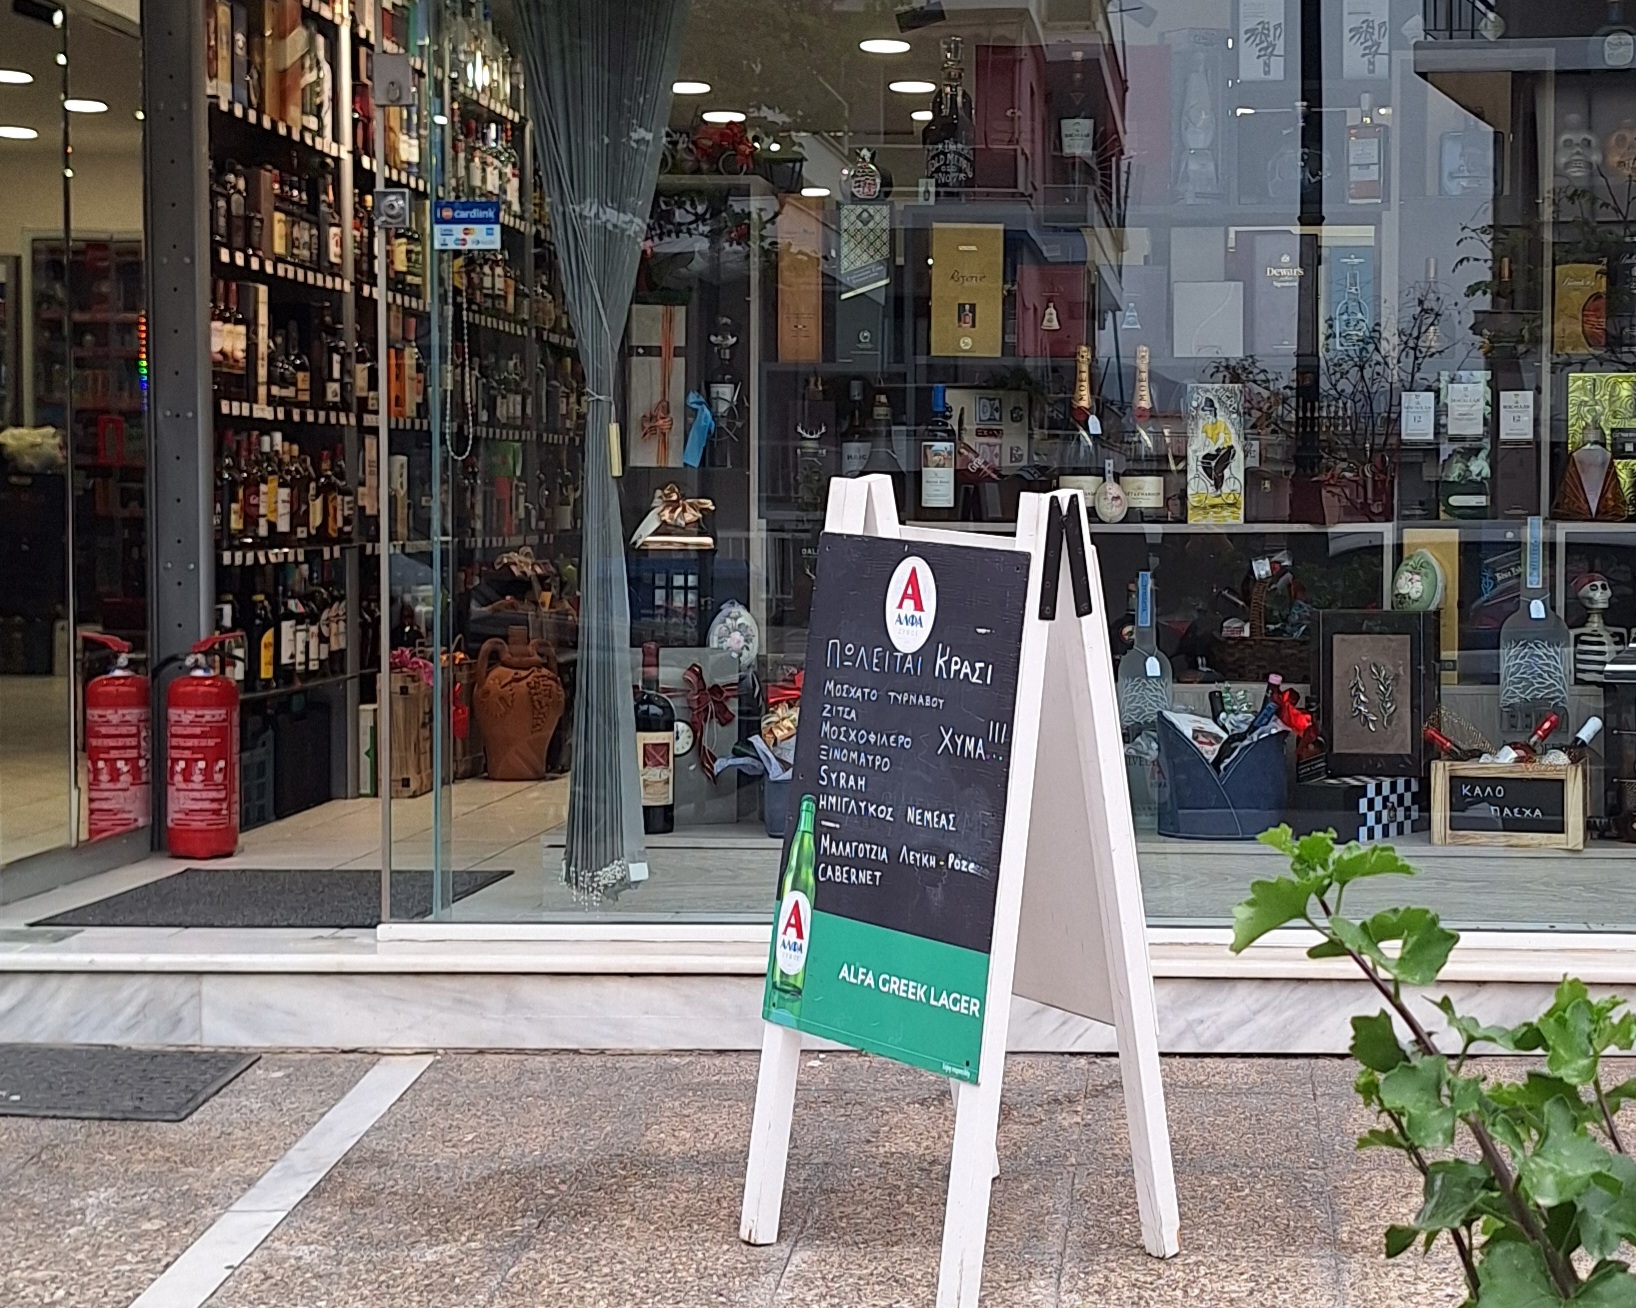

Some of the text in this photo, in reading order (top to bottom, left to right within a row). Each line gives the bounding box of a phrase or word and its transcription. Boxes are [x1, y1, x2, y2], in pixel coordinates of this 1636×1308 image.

[454, 207, 496, 219] cardlink
[1266, 266, 1304, 277] Dewar's
[826, 639, 994, 686] ΠΩΛΕΙΤΑΙ ΚΡΑΣΙ
[824, 679, 945, 711] ΜΟΣΧΑΤΟ ΤΥΡΝΑΒΟΥ
[821, 703, 858, 722] ΖΙΤΣΑ
[820, 720, 913, 750] ΜΟΣΧΟΦΙΛΕΡΟ
[818, 744, 891, 773] ΞΙΝΟΜΑΥΡΟ
[818, 765, 867, 792] SYRAH
[1462, 783, 1505, 798] ΚΑΛΟ
[818, 793, 957, 832] ΗΜΙΓΛΥΚΟΣ ΝΕΜΕΑΣ
[820, 833, 889, 864] ΜΑΛΑΓΟΥΖΙΑ
[818, 863, 883, 887] CABERNET
[838, 962, 981, 1018] ALFA GREEK LAGER
